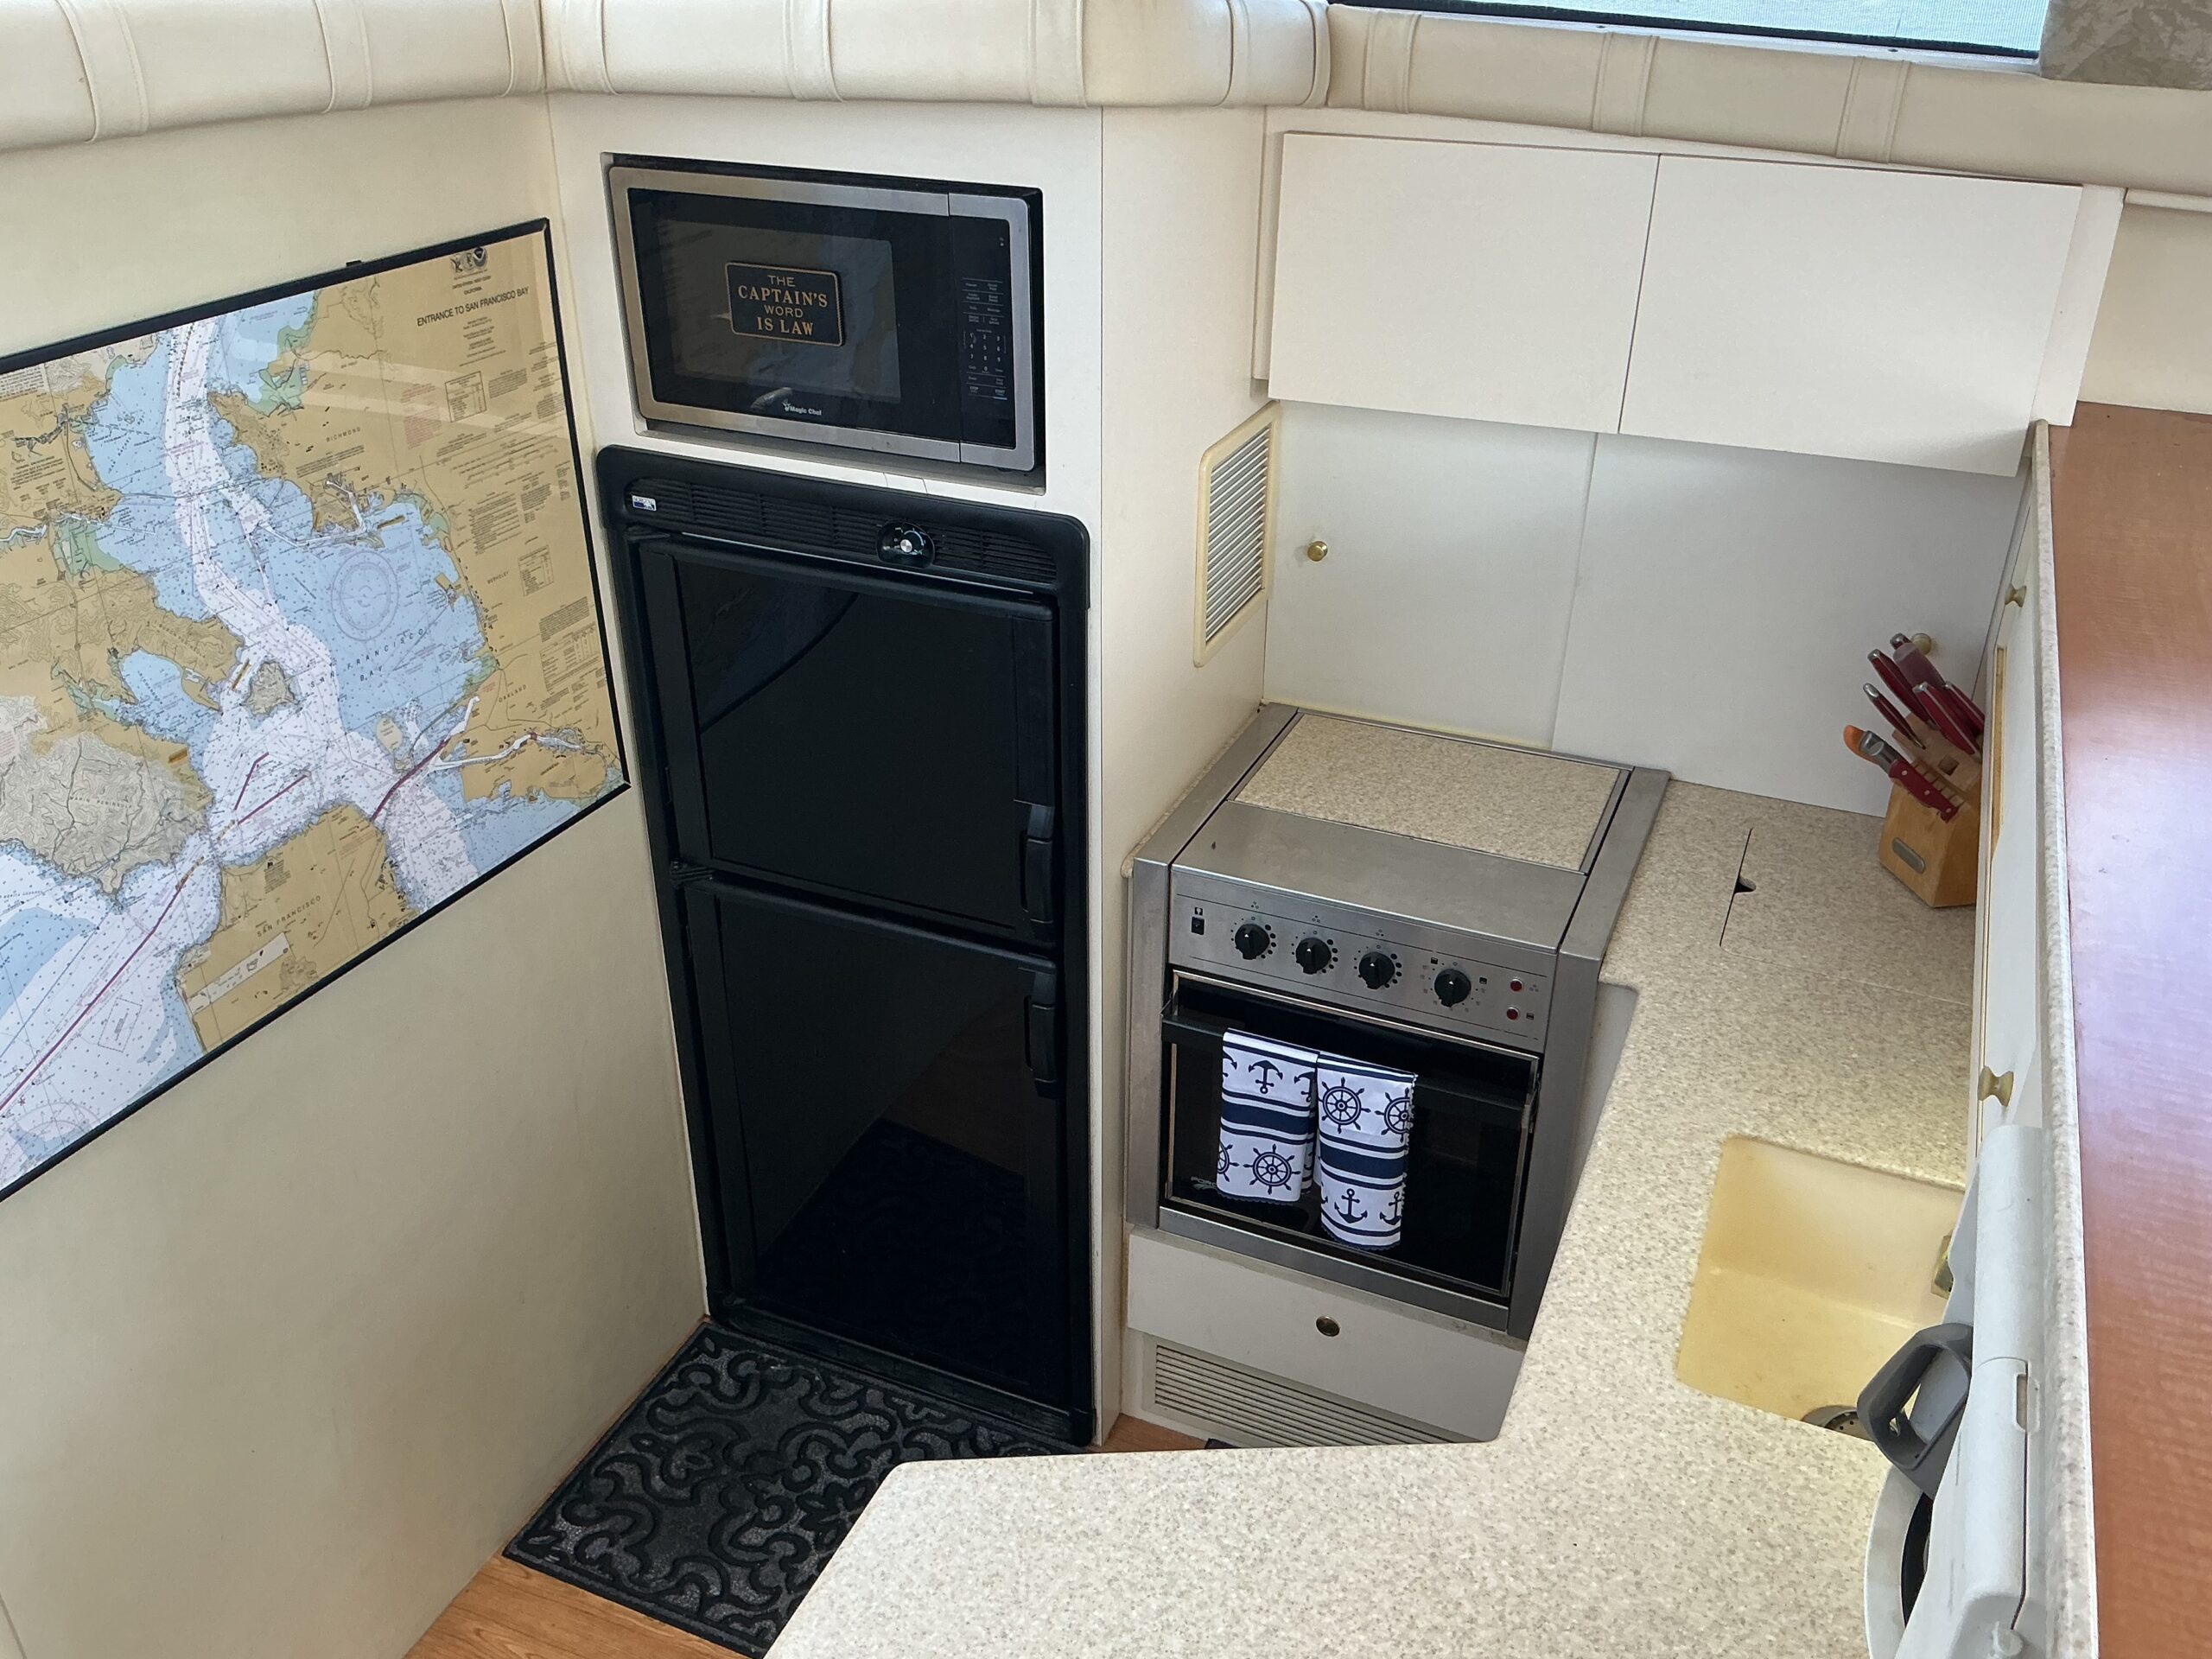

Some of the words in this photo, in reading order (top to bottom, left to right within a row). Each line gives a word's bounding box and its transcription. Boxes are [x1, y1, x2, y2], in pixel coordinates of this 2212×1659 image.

[767, 275, 796, 287] THE
[738, 285, 828, 308] CAPTAIN'S
[416, 308, 454, 327] ENTRANCE
[454, 305, 465, 315] TO
[465, 301, 480, 313] SAN
[480, 289, 518, 308] FRANCISCO
[517, 286, 530, 297] BAY
[764, 304, 804, 318] WORD
[757, 316, 774, 331] IS
[779, 319, 814, 336] LAW
[790, 405, 807, 414] Magic
[326, 427, 361, 442] RICHMOND
[257, 925, 273, 938] SAN
[276, 895, 321, 925] FRANCISCO
